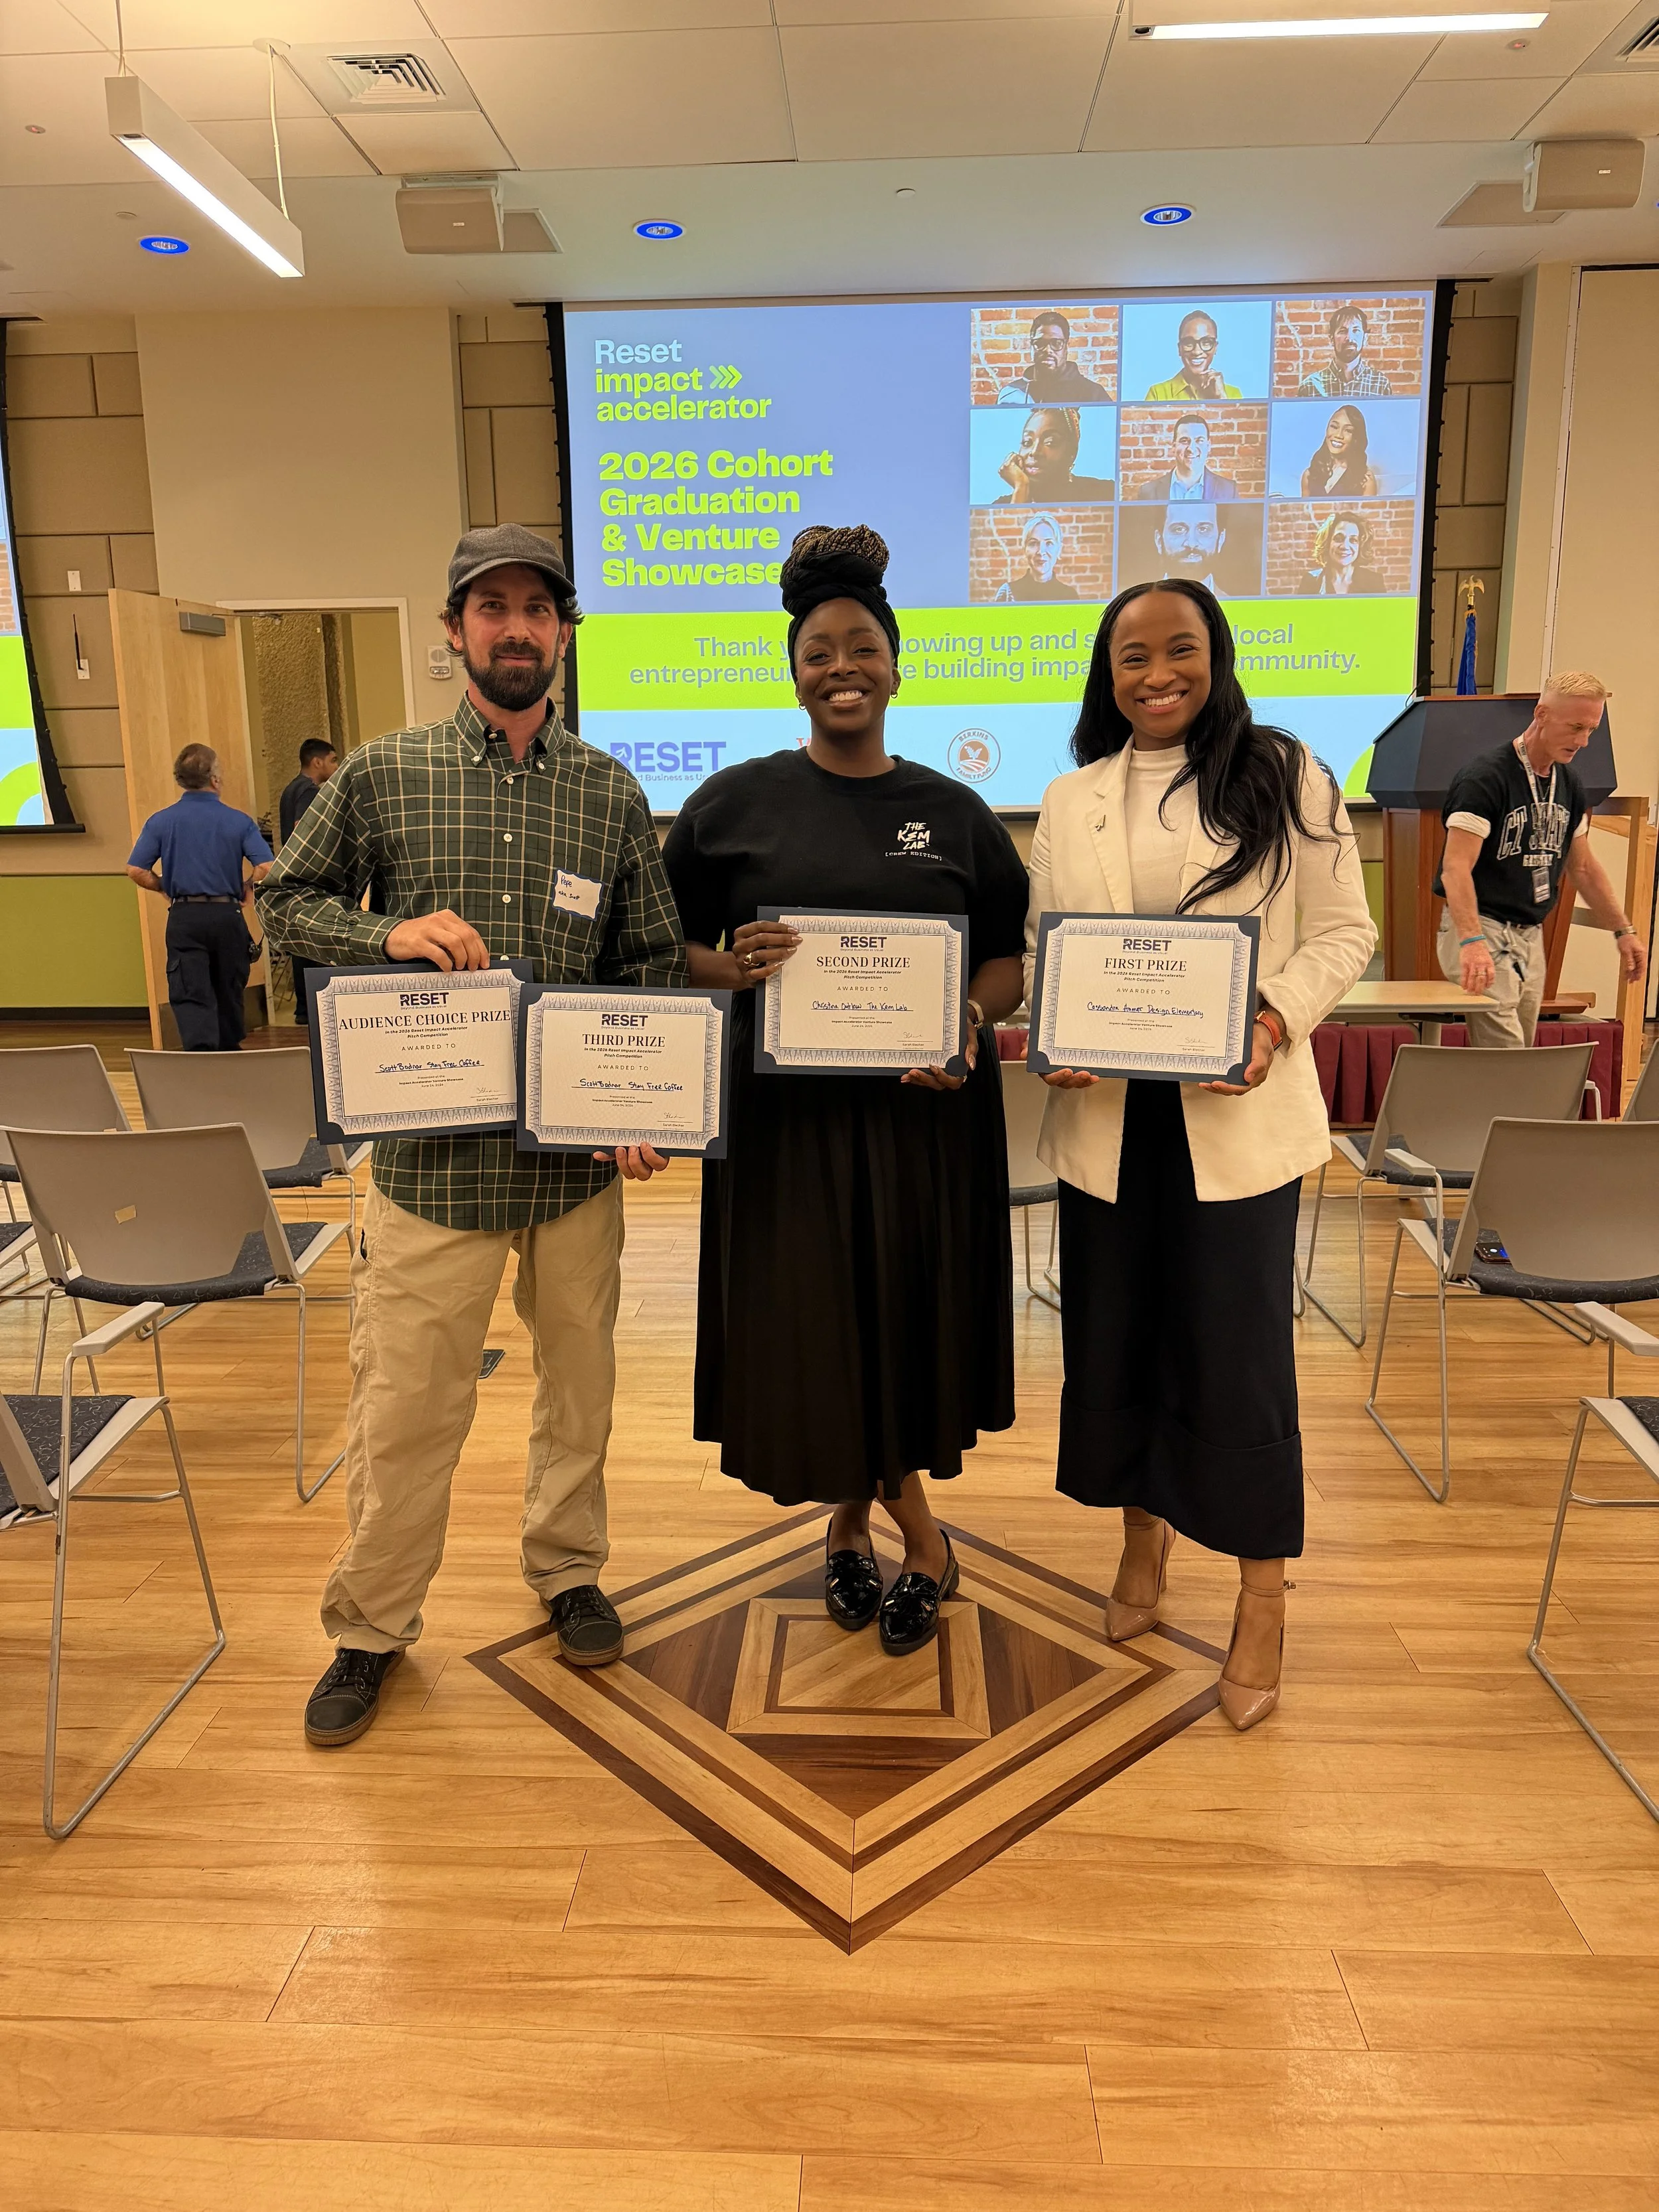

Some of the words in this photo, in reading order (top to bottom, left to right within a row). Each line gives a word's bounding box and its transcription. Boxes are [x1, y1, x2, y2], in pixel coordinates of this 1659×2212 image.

[595, 339, 682, 364] Reset
[595, 368, 703, 399] impact
[597, 394, 772, 421] accelerator
[599, 450, 699, 480] 2026
[707, 448, 833, 479] Cohort
[600, 486, 800, 516] Graduation
[602, 523, 627, 552] &
[635, 523, 780, 552] Venture
[603, 557, 782, 587] Showcase
[693, 635, 773, 657] Thank
[900, 632, 983, 657] owing
[991, 634, 1023, 656] up
[1030, 628, 1077, 650] and
[1233, 623, 1293, 645] local
[629, 665, 791, 688] entrepreneur
[924, 657, 1024, 683] building
[1032, 656, 1091, 681] impa
[1235, 649, 1360, 674] mmunity.
[610, 741, 727, 773] RESET
[904, 822, 927, 831] THE
[897, 830, 930, 843] KEM
[840, 936, 887, 948] RESET
[1122, 938, 1172, 951] RESET
[816, 956, 869, 967] SECOND
[872, 957, 910, 968] PRIZE
[1104, 958, 1143, 969] FIRST
[1147, 960, 1187, 972] PRIZE
[399, 992, 449, 1007] RESET
[867, 1001, 877, 1010] The
[1147, 1004, 1170, 1016] Design
[338, 1014, 412, 1030] AUDIENCE
[415, 1011, 468, 1026] CHOICE
[471, 1009, 511, 1023] PRIZE
[601, 1013, 648, 1027] RESET
[582, 1033, 624, 1046] THIRD
[627, 1035, 666, 1047] PRIZE
[401, 1043, 442, 1052] AWARDED
[628, 1081, 645, 1090] Stay
